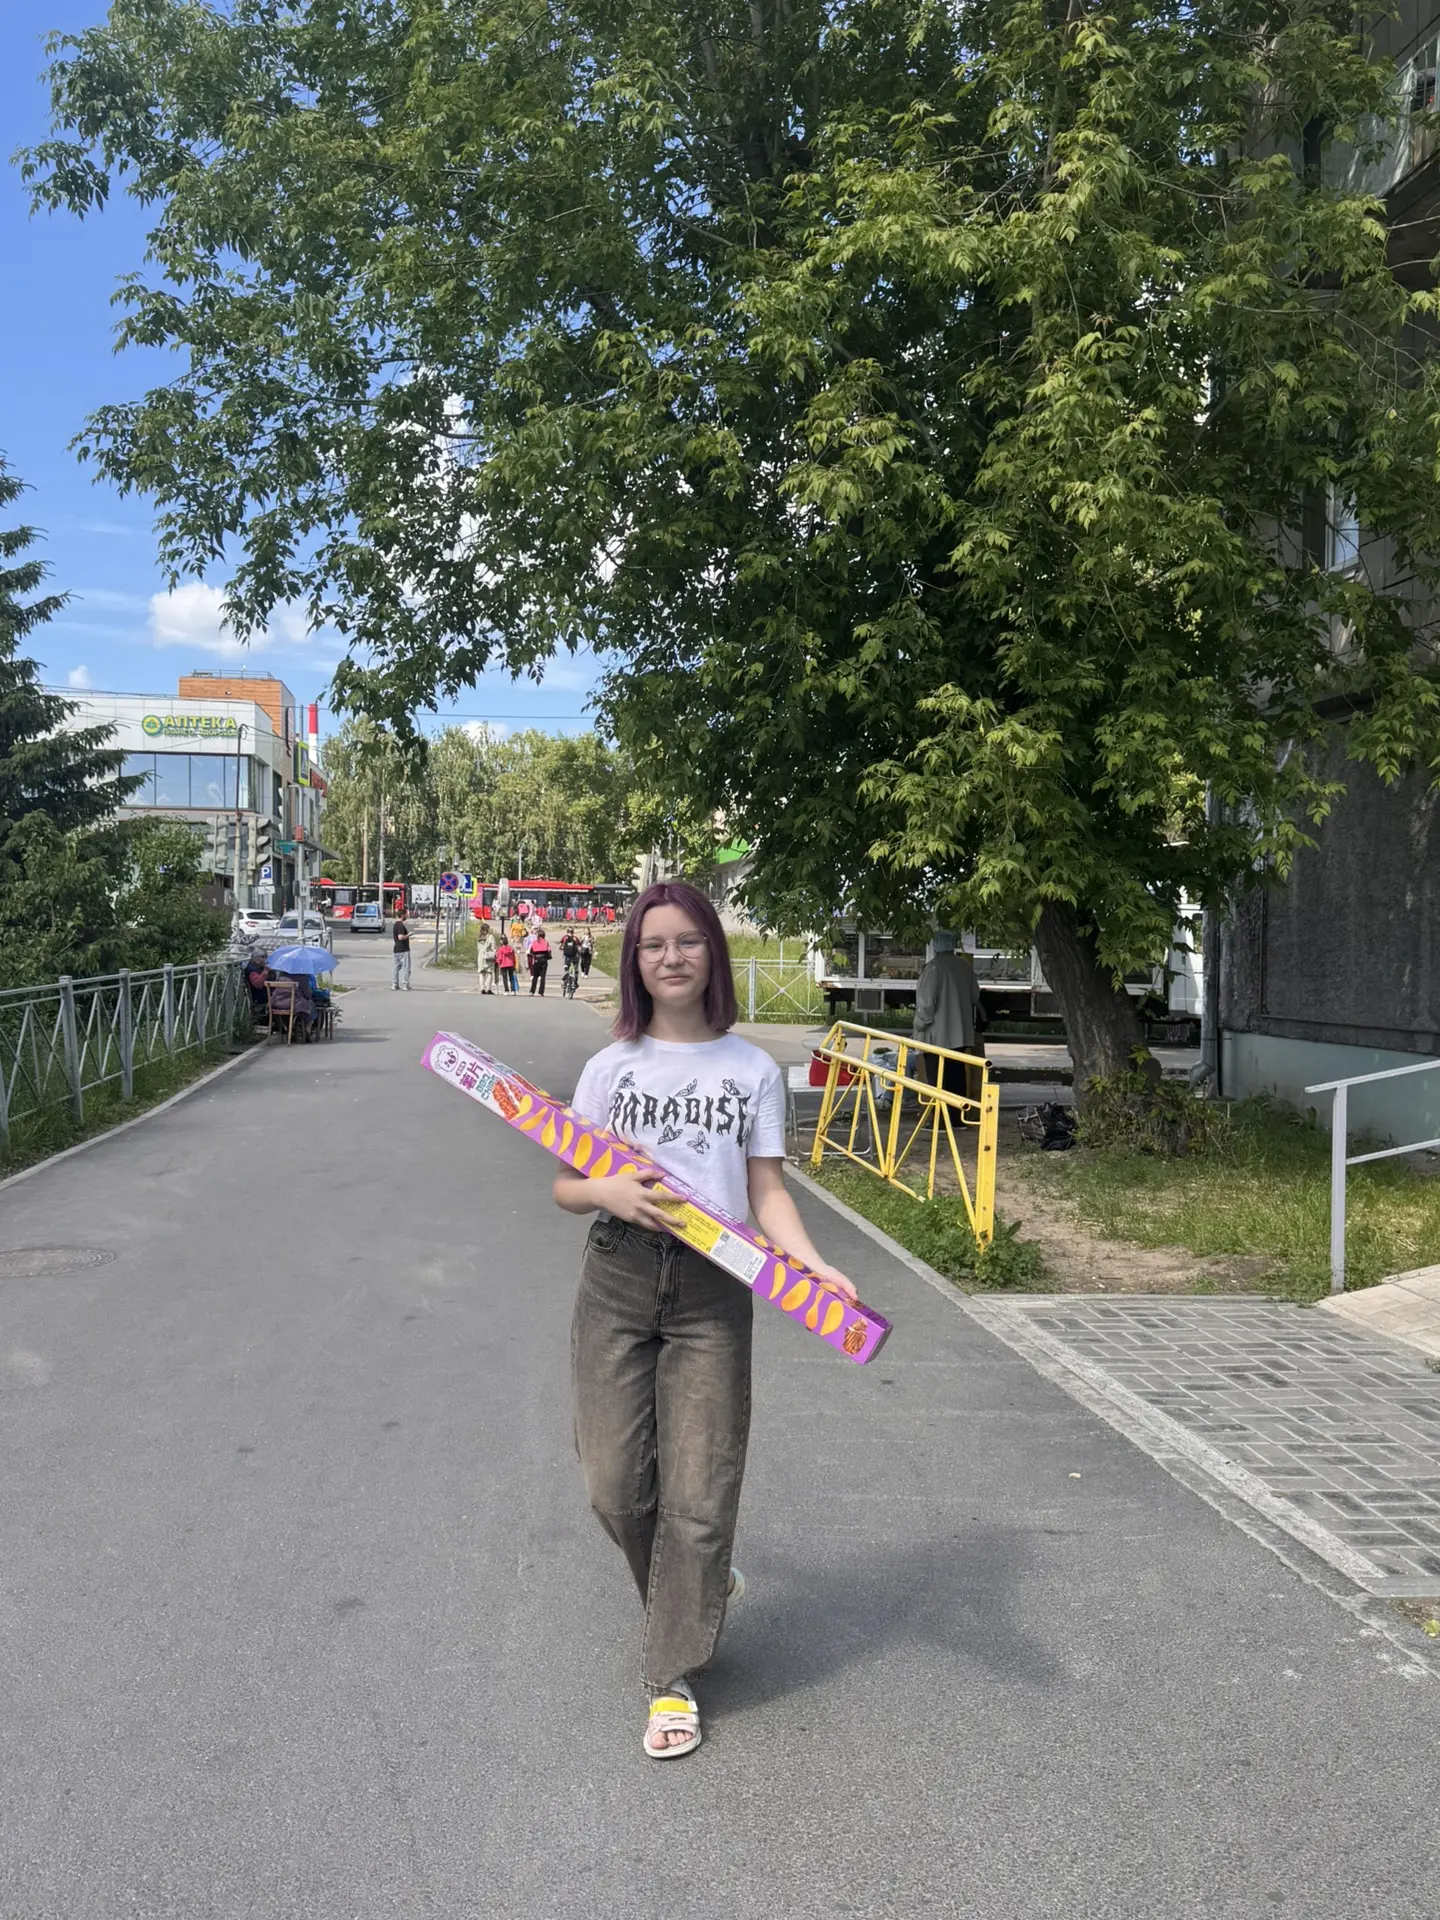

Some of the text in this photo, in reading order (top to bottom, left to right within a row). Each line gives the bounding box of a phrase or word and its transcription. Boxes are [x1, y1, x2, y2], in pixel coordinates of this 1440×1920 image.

[164, 715, 237, 729] АПТЕКА
[261, 867, 270, 878] P
[476, 1073, 490, 1093] BBQ
